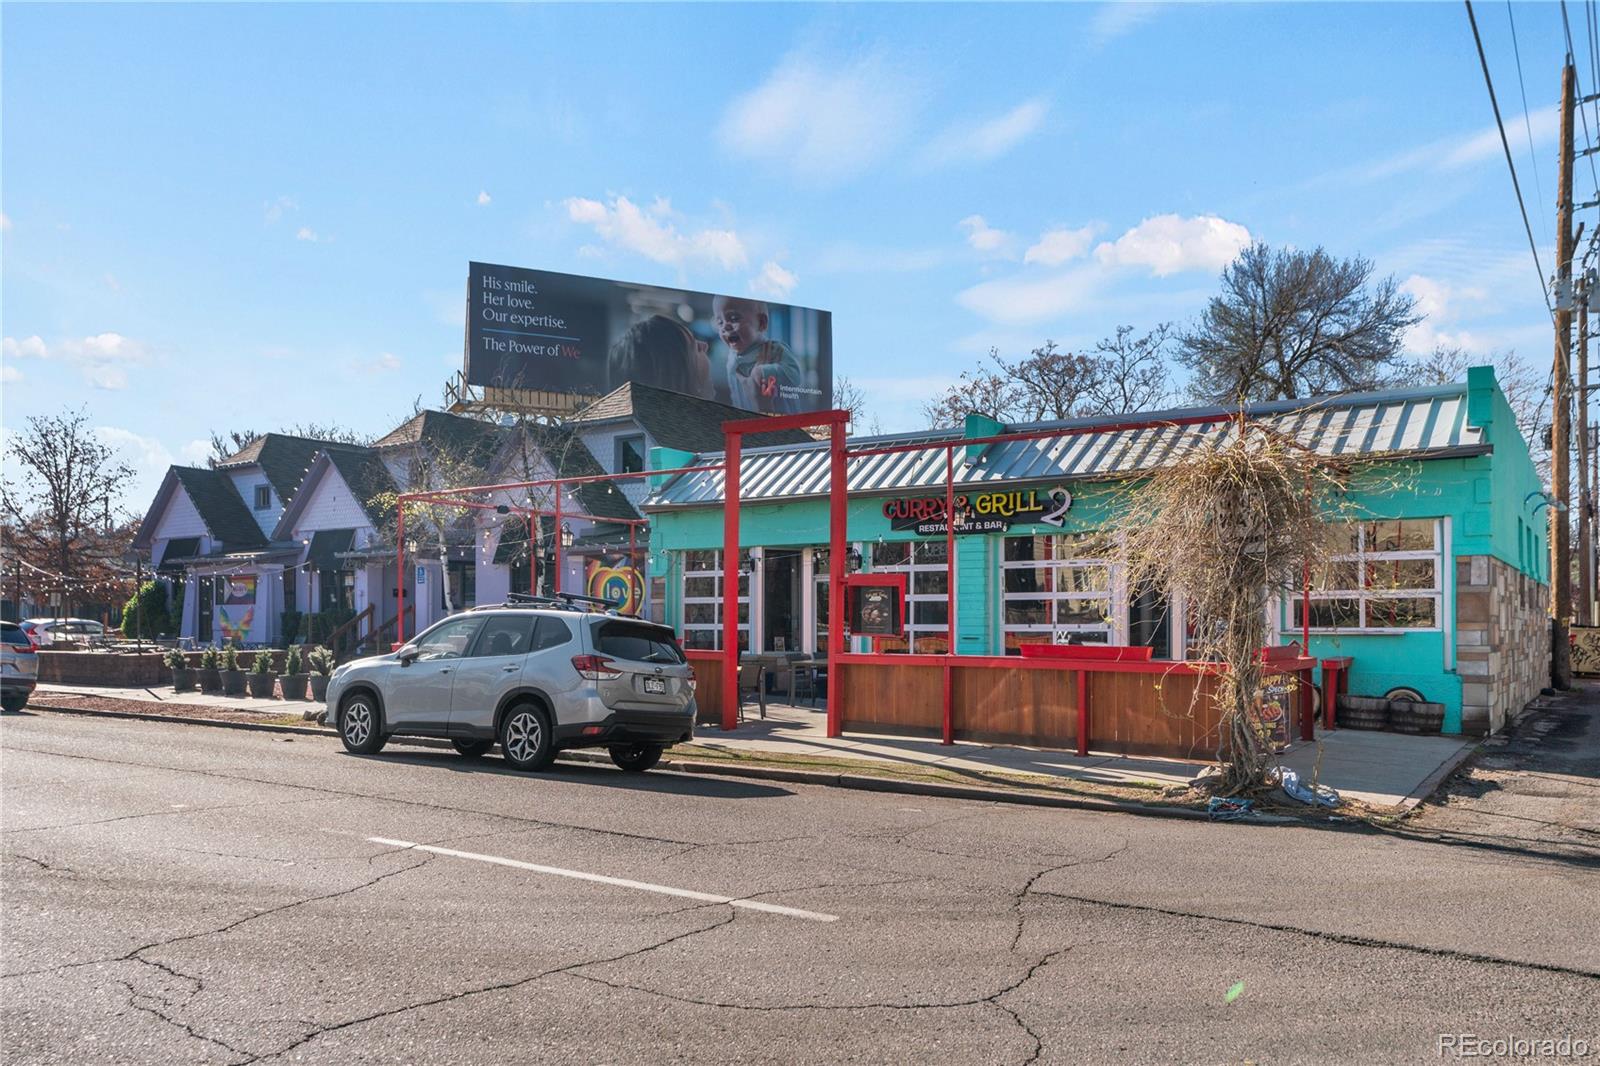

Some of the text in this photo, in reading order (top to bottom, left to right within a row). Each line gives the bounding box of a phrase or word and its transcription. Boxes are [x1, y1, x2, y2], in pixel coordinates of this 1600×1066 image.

[483, 275, 538, 294] His smile.
[483, 291, 535, 310] Her love.
[482, 308, 567, 329] Our expertise.
[483, 336, 580, 359] The Power of We
[882, 495, 951, 521] CURRY
[976, 491, 1043, 517] GRILL
[1040, 486, 1072, 528] 2
[918, 521, 1003, 533] RESTAUNT & BAR
